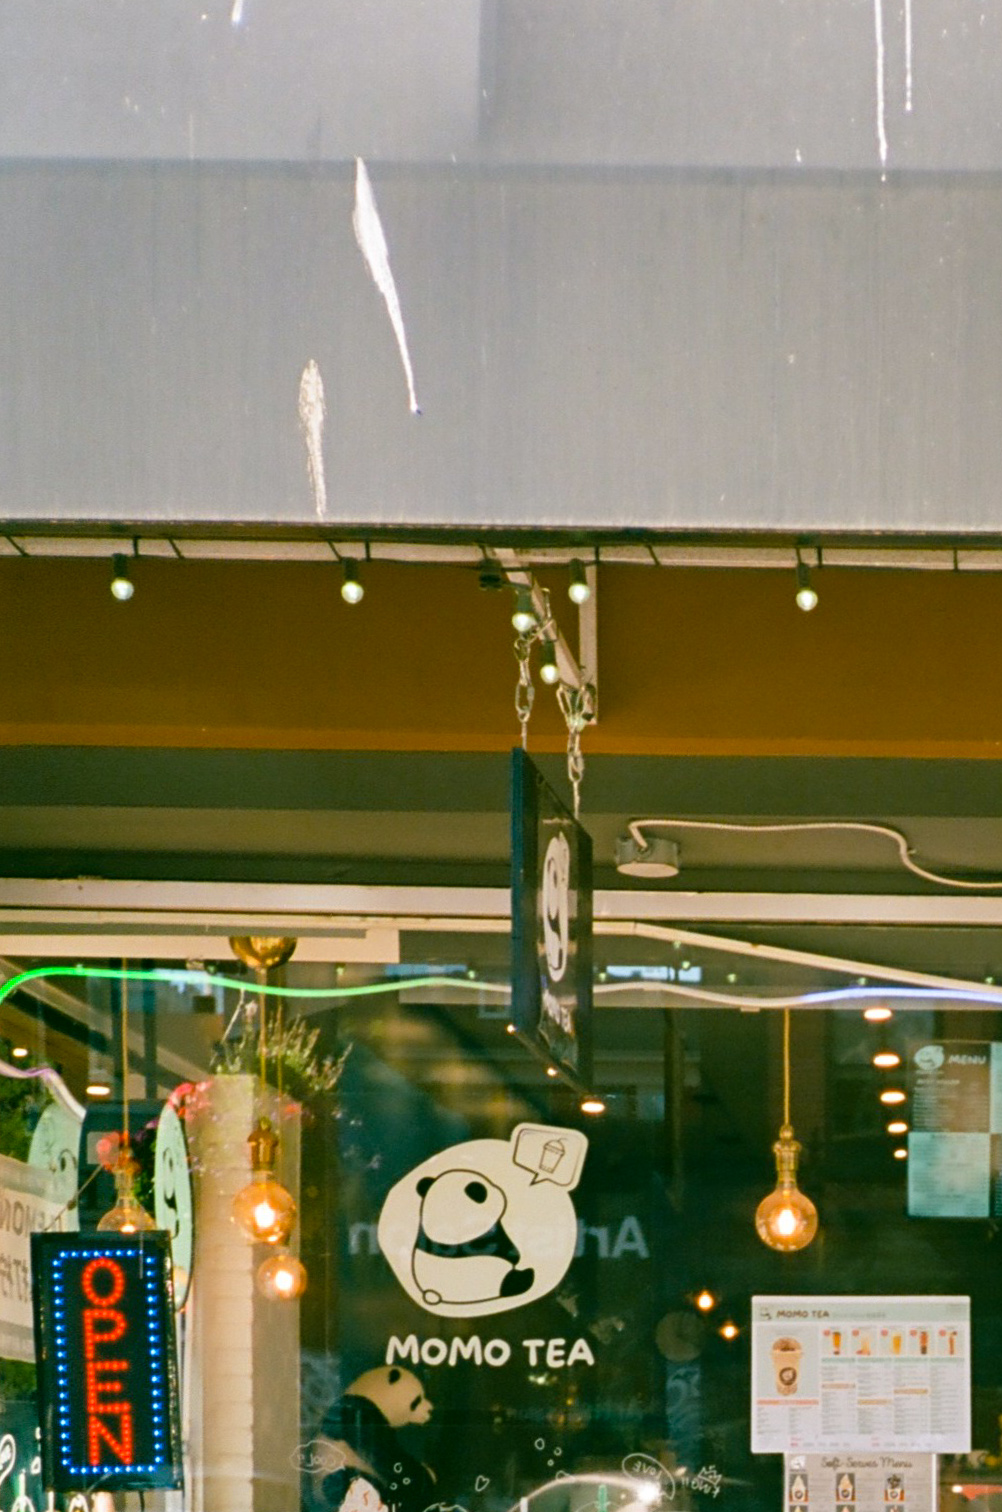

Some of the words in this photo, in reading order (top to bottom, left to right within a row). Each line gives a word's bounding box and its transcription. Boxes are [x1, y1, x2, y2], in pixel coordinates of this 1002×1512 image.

[82, 1257, 132, 1466] OPEN
[385, 1334, 511, 1367] MOMO
[522, 1337, 595, 1368] TEA
